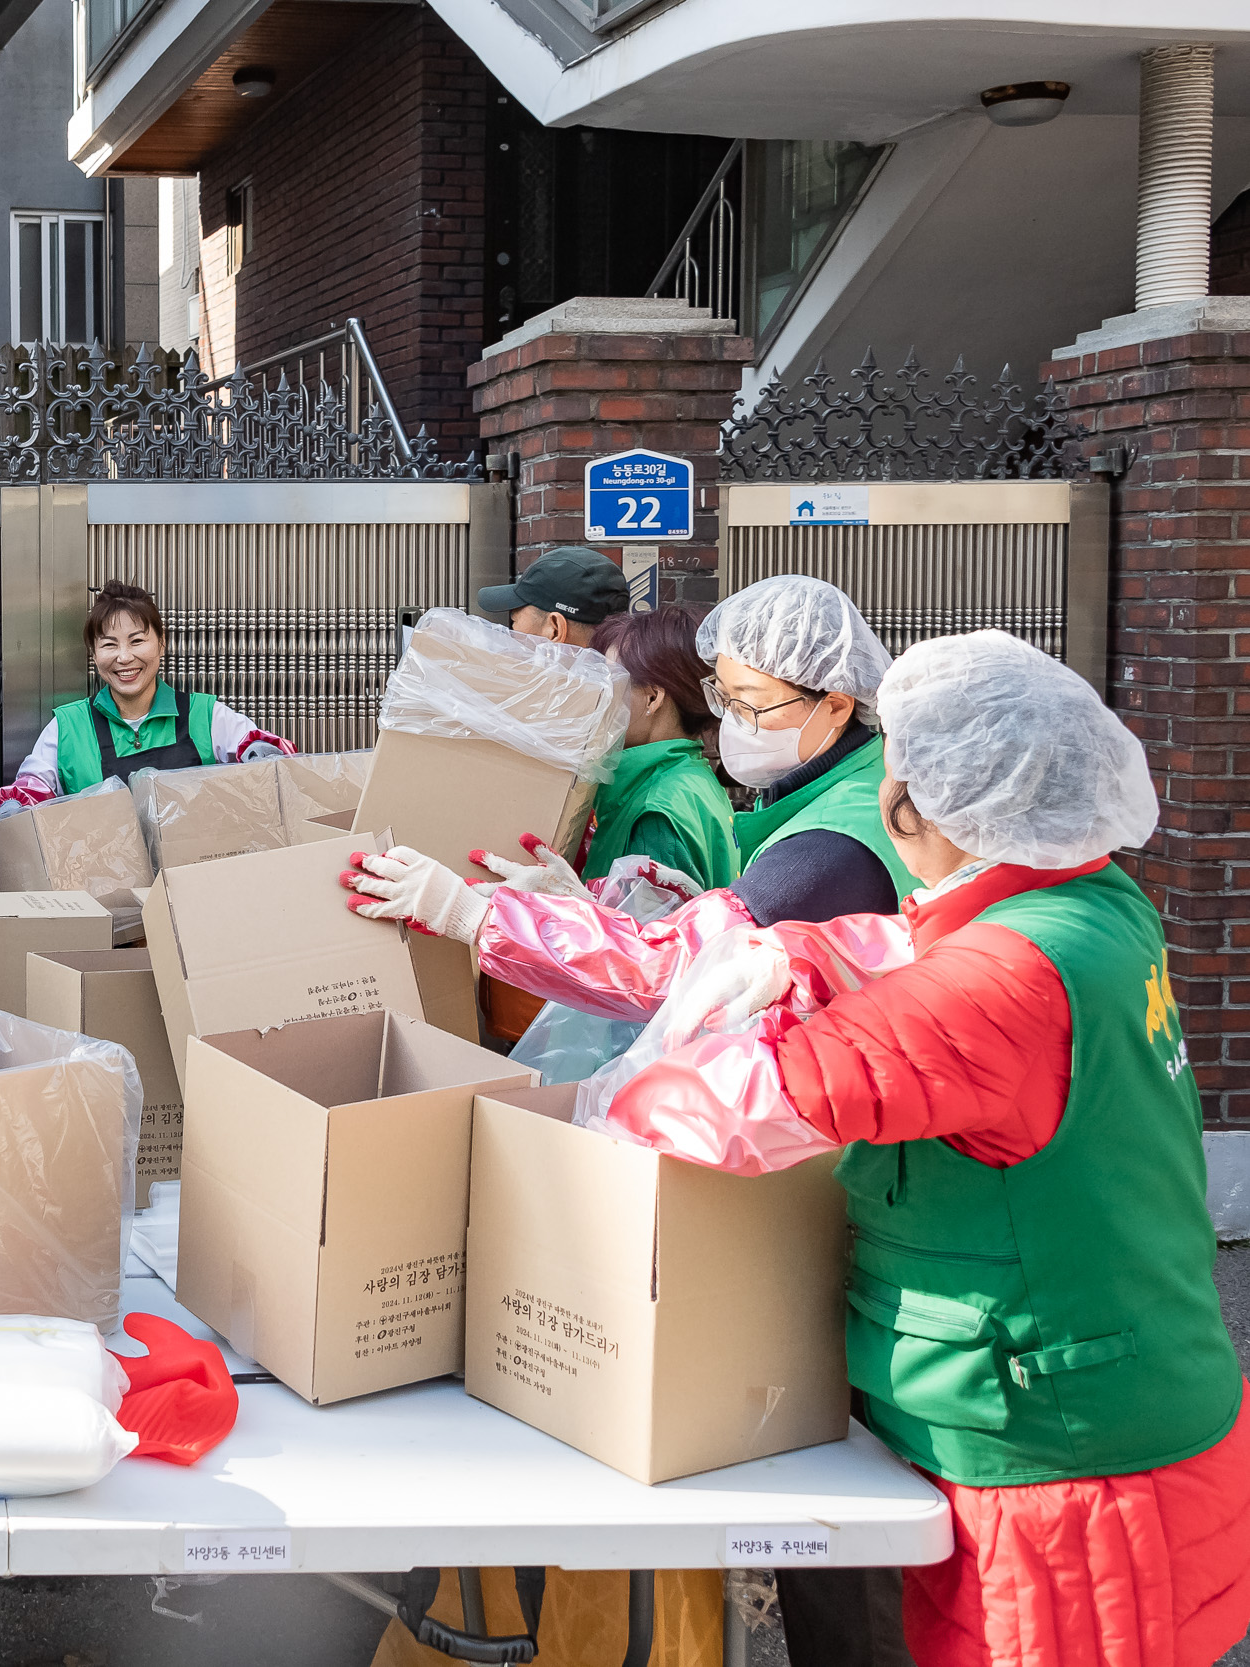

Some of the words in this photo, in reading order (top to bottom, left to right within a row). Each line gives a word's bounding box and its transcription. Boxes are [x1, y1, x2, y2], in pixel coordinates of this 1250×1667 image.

[603, 478, 654, 486] Neungdong-ro
[656, 477, 676, 486] 30-gil
[612, 464, 667, 477] 능동로30길
[617, 497, 661, 528] 22
[162, 1112, 184, 1125] 김장
[138, 1168, 158, 1177] 이마트
[160, 1166, 179, 1175] 자양점
[146, 1156, 173, 1165] 광진구청
[380, 1263, 404, 1275] 2024년
[406, 1258, 425, 1270] 광진구
[426, 1254, 445, 1265] 따뜻한
[447, 1252, 460, 1261] 겨울
[363, 1274, 400, 1295] 사랑의
[406, 1268, 431, 1287] 김장
[382, 1298, 400, 1309] 2024.
[402, 1296, 413, 1305] 11.
[415, 1291, 434, 1302] 12(화)
[514, 1288, 535, 1304] 2024년
[536, 1297, 553, 1311] 광진구
[554, 1306, 571, 1319] 따뜻한
[572, 1313, 584, 1325] 겨울
[586, 1320, 603, 1333] 보내기
[356, 1320, 370, 1330] 주관
[388, 1302, 451, 1323] 광진구새마을부녀회
[501, 1294, 531, 1321] 사랑의
[536, 1310, 559, 1332] 김장
[562, 1322, 619, 1360] 담가드리기
[355, 1334, 369, 1345] 후원
[388, 1324, 416, 1338] 광진구청
[376, 1342, 399, 1353] 이마트
[400, 1336, 422, 1349] 자양점
[496, 1332, 508, 1345] 주관
[522, 1343, 578, 1378] 광진구새마을부녀회
[516, 1326, 532, 1339] 2024.
[534, 1333, 543, 1344] 11.
[544, 1338, 562, 1353] 12(화)
[572, 1350, 601, 1370] 11.13(수)
[496, 1346, 508, 1359] 후원
[521, 1360, 546, 1378] 광진구청
[514, 1371, 532, 1386] 이마트
[534, 1381, 552, 1396] 자양점
[187, 1546, 230, 1560] 자양3동
[238, 1545, 286, 1560] 주민센터
[732, 1540, 774, 1554] 자양3동
[781, 1540, 828, 1555] 주민센터
